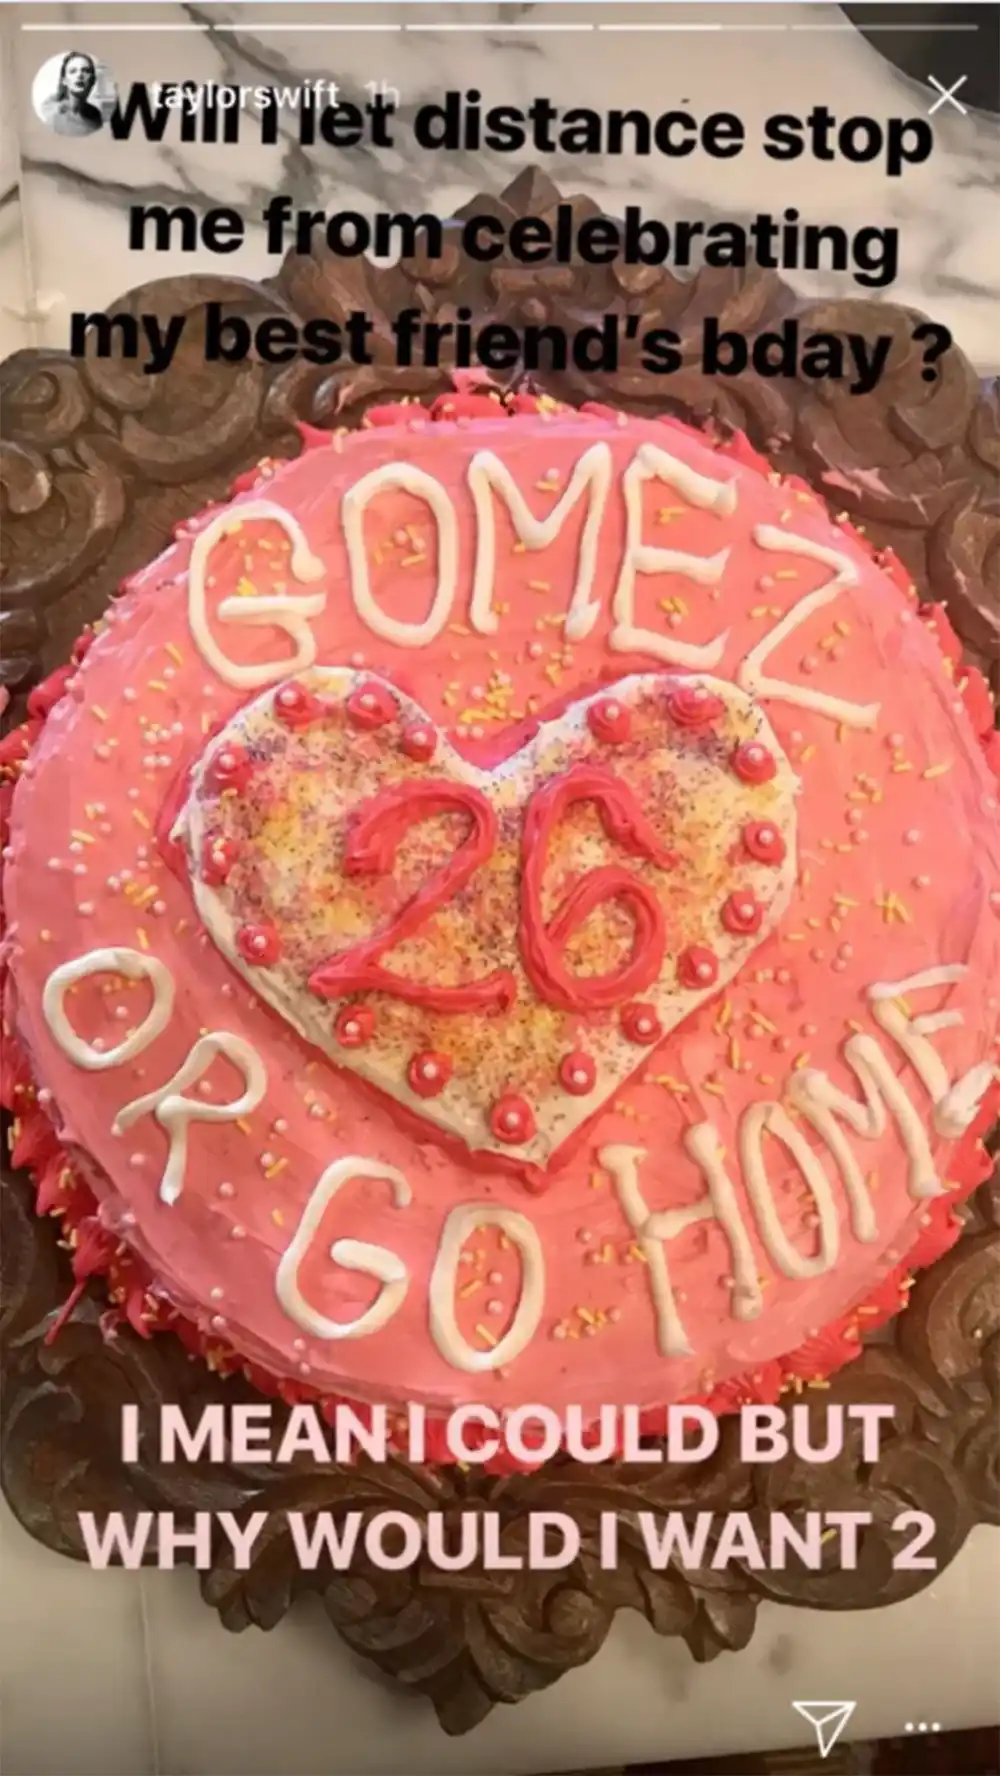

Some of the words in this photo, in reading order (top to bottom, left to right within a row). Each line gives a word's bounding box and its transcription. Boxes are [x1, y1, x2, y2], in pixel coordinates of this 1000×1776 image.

[188, 442, 882, 729] GOMEZ
[308, 763, 679, 1013] 26
[42, 947, 268, 1205] OR
[277, 1155, 546, 1373] GO
[599, 964, 1000, 1358] HOME
